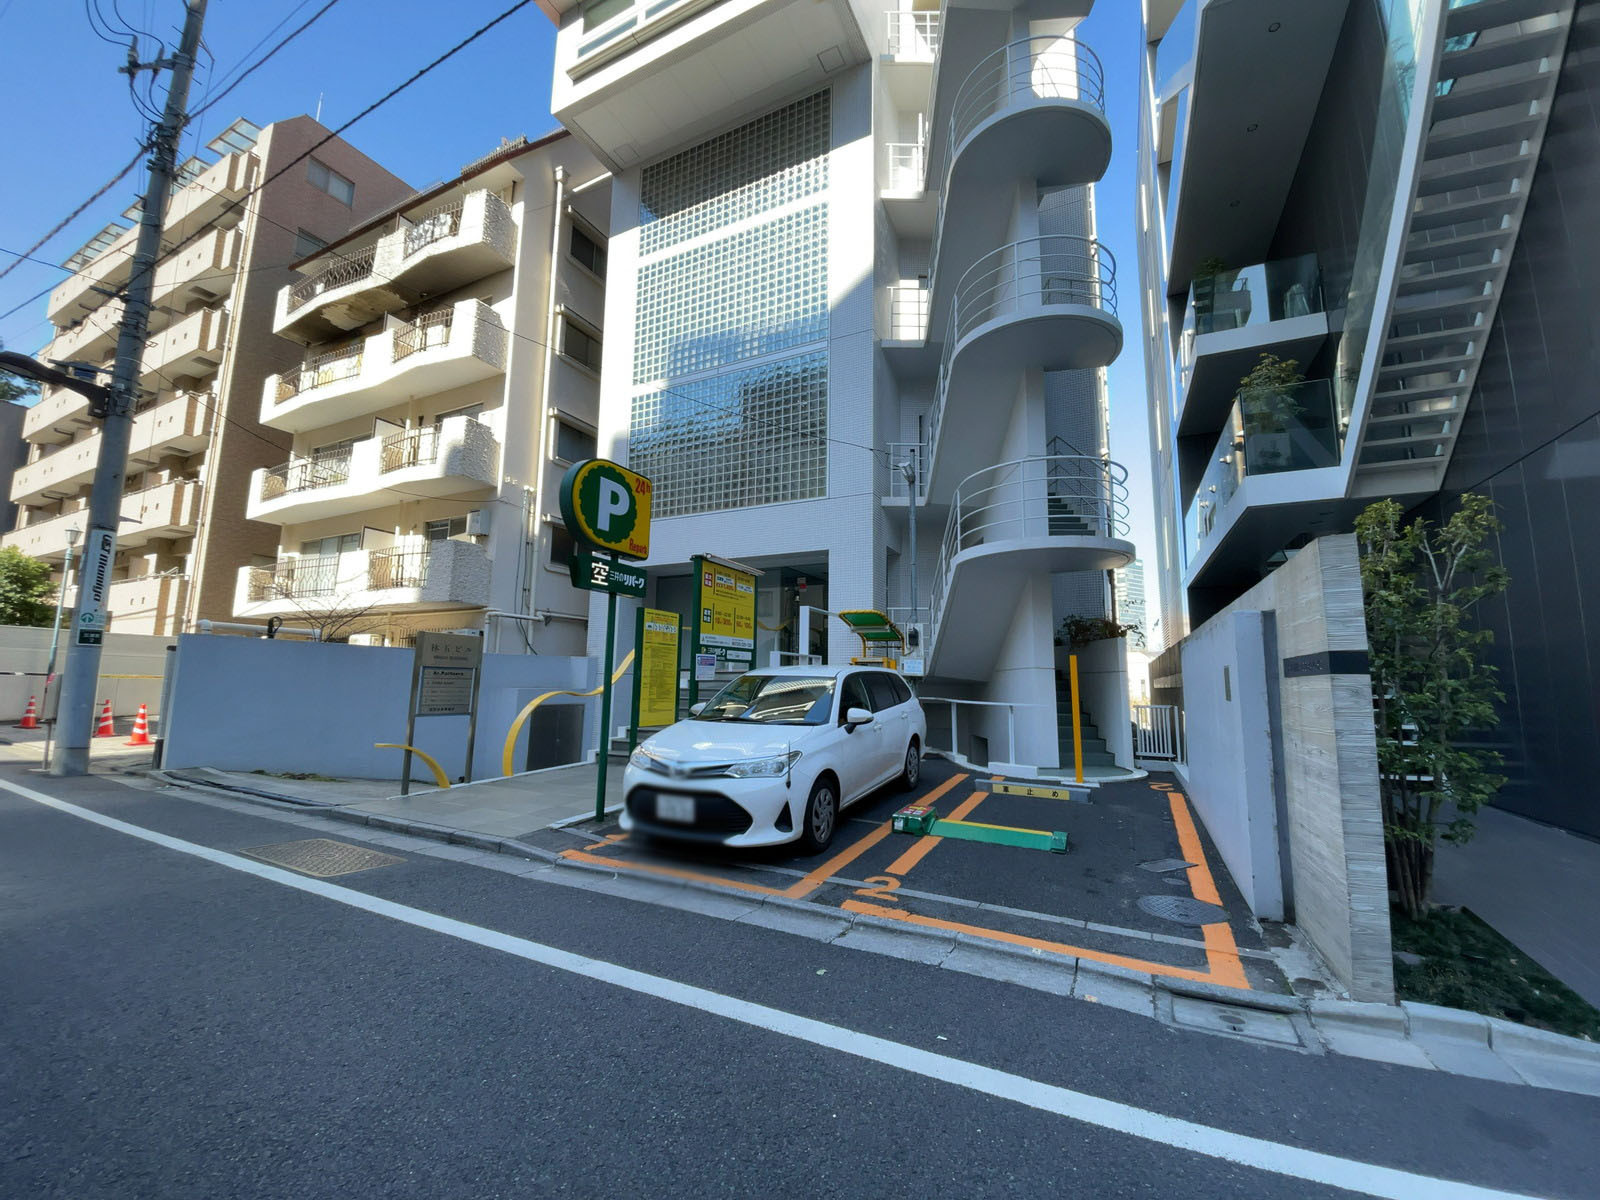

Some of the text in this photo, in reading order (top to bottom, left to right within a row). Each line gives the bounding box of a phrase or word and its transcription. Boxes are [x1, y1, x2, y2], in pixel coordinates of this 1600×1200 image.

[597, 476, 630, 532] P
[590, 561, 609, 586] 空
[609, 570, 645, 589] 三井のリパーク
[853, 876, 899, 902] 2
